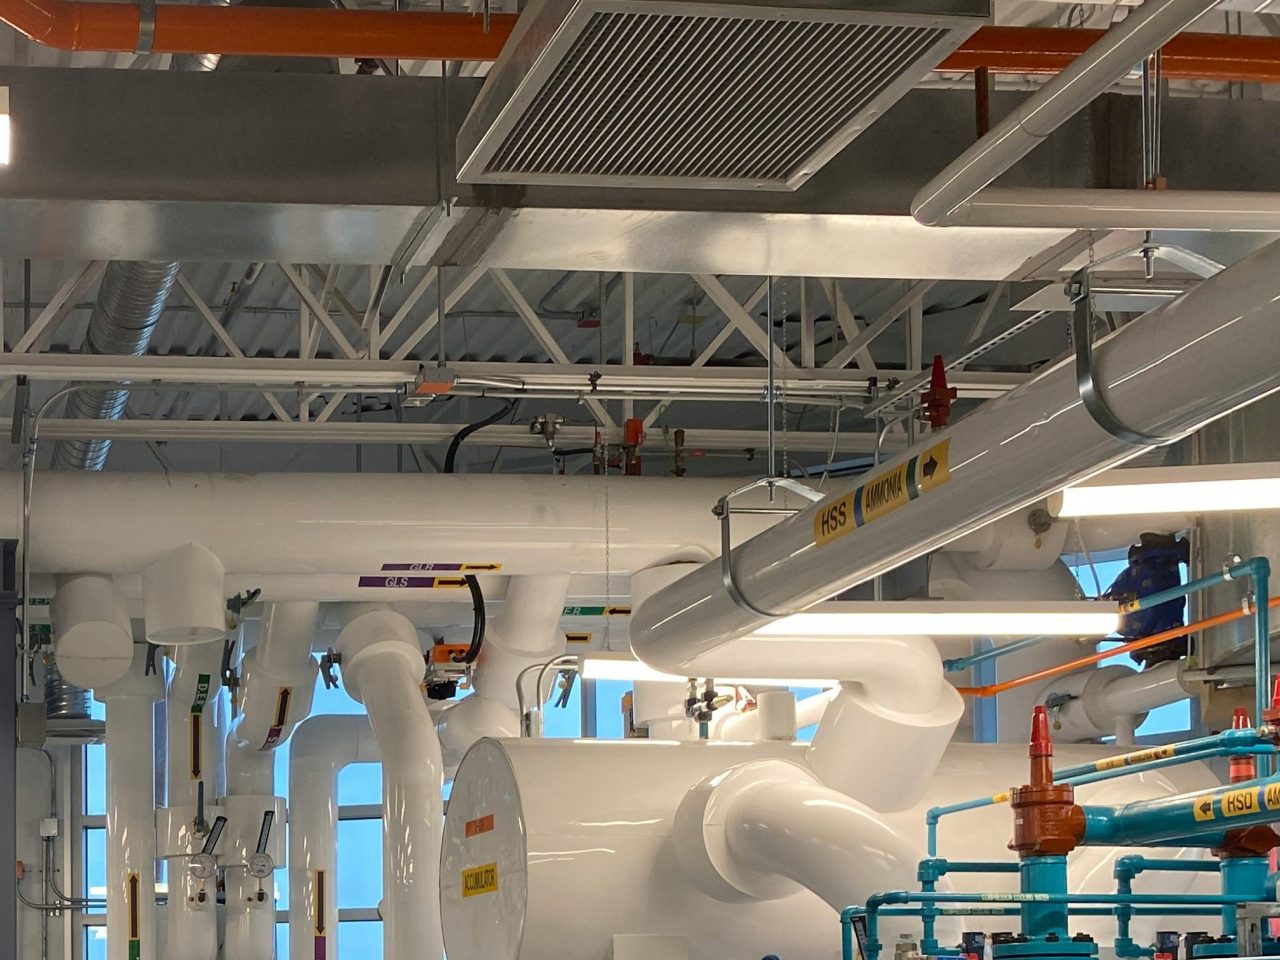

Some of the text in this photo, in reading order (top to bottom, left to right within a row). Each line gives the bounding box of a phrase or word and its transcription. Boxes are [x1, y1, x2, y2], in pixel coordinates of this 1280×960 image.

[821, 471, 903, 534] HSS AMMONIA
[385, 576, 408, 587] GLS
[1267, 786, 1280, 806] AM
[464, 867, 495, 891] ACCUMULATOR
